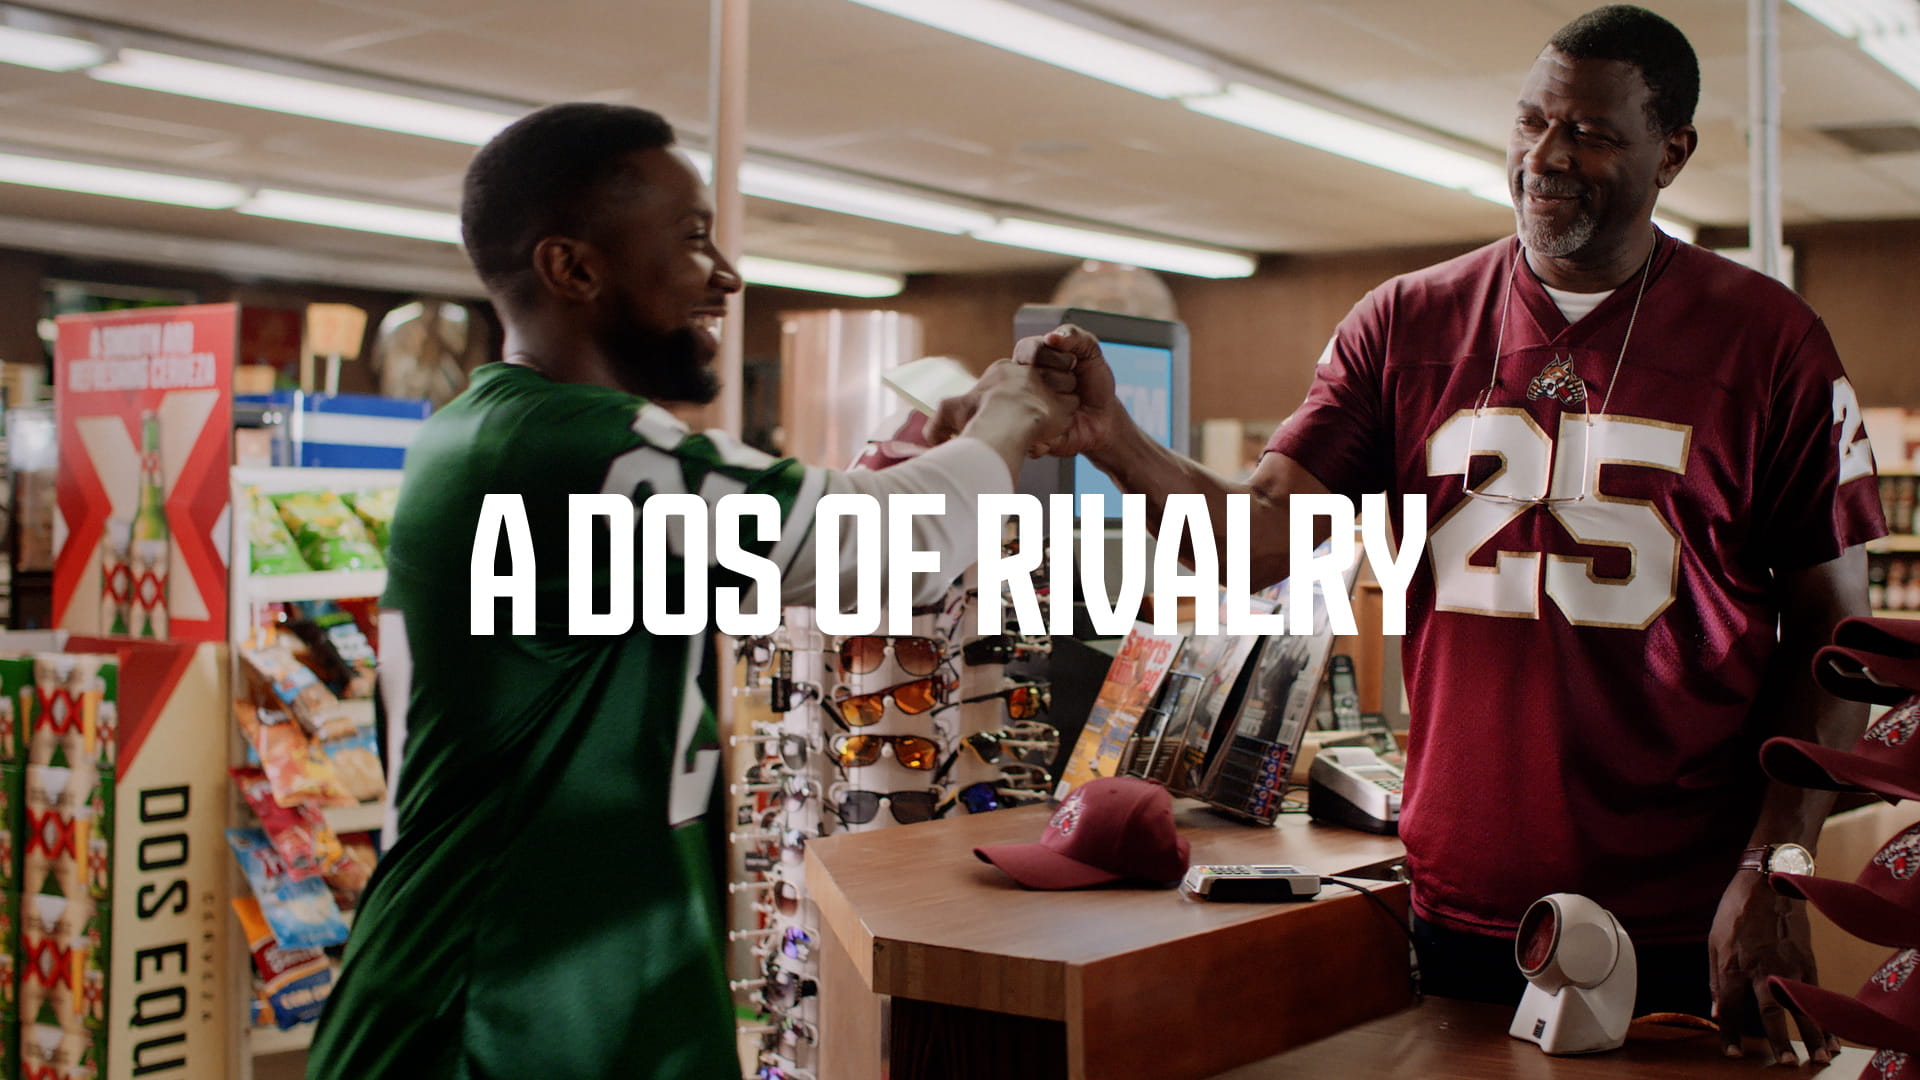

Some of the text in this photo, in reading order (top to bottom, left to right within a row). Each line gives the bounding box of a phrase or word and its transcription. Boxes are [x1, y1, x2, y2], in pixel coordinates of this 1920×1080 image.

[1425, 407, 1693, 631] 25
[128, 785, 190, 1078] DOS EQU
